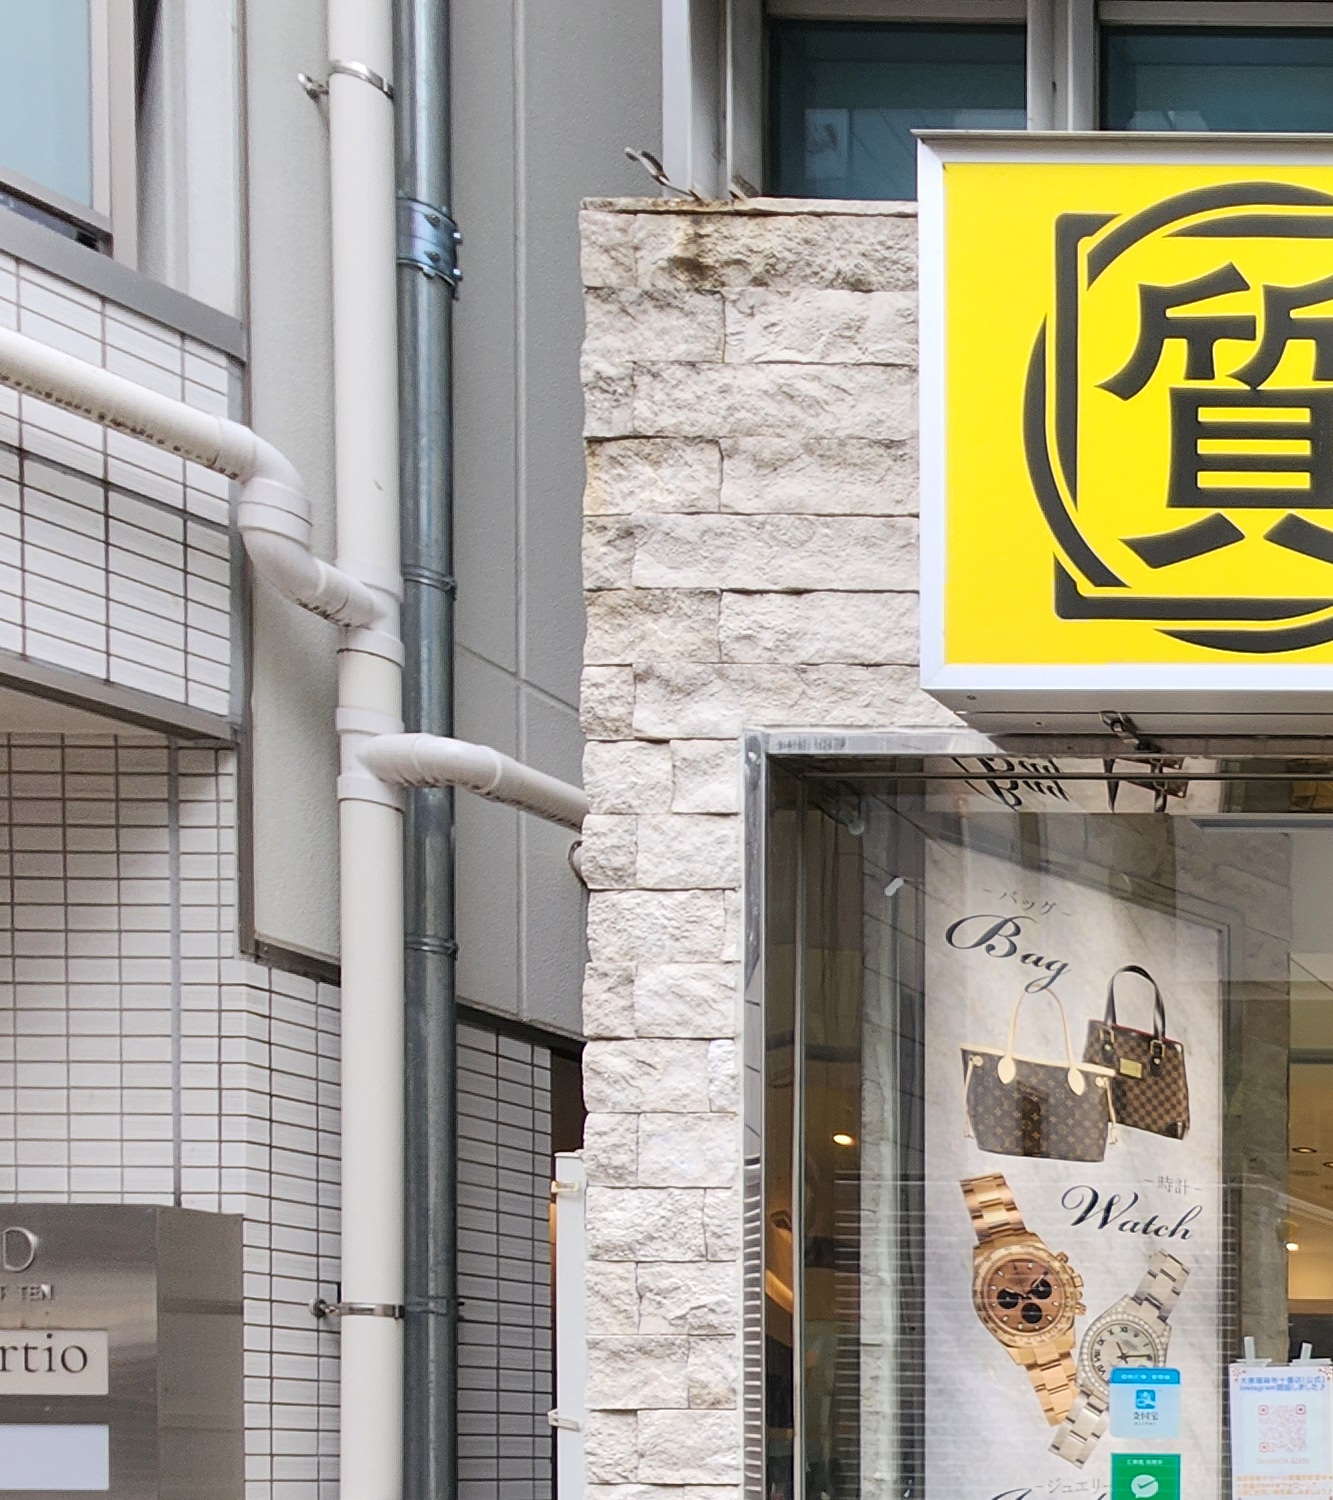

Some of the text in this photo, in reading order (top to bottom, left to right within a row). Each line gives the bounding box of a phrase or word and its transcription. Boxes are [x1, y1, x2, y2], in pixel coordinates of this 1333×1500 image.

[945, 913, 1071, 993] Bag
[1061, 1185, 1203, 1241] Watch
[1157, 1175, 1190, 1195] 時計
